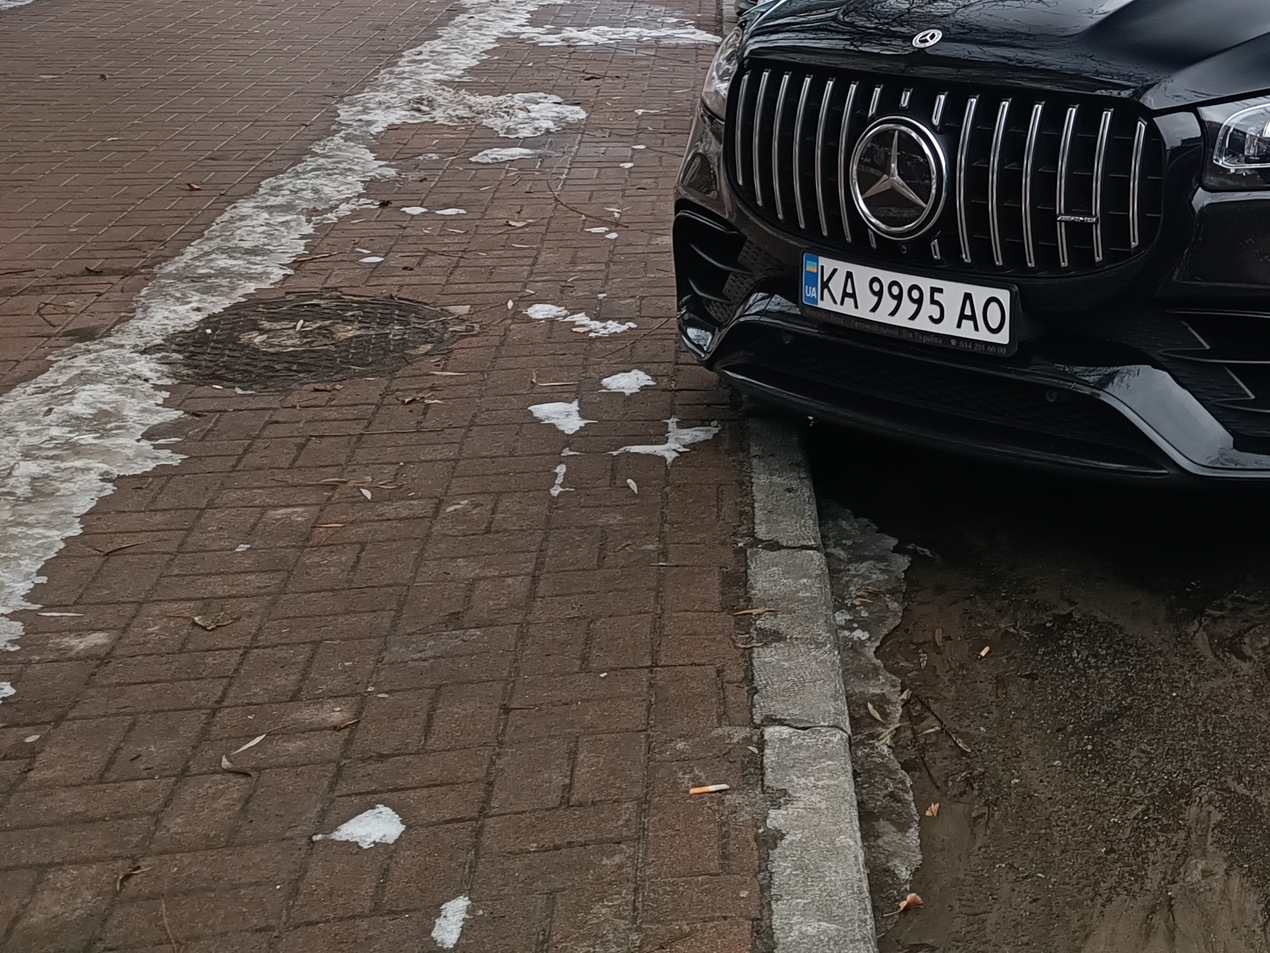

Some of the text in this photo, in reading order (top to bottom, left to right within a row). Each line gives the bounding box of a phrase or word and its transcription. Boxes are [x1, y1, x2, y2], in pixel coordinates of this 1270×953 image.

[805, 285, 817, 299] UA
[820, 264, 1006, 334] KA 9995 AO
